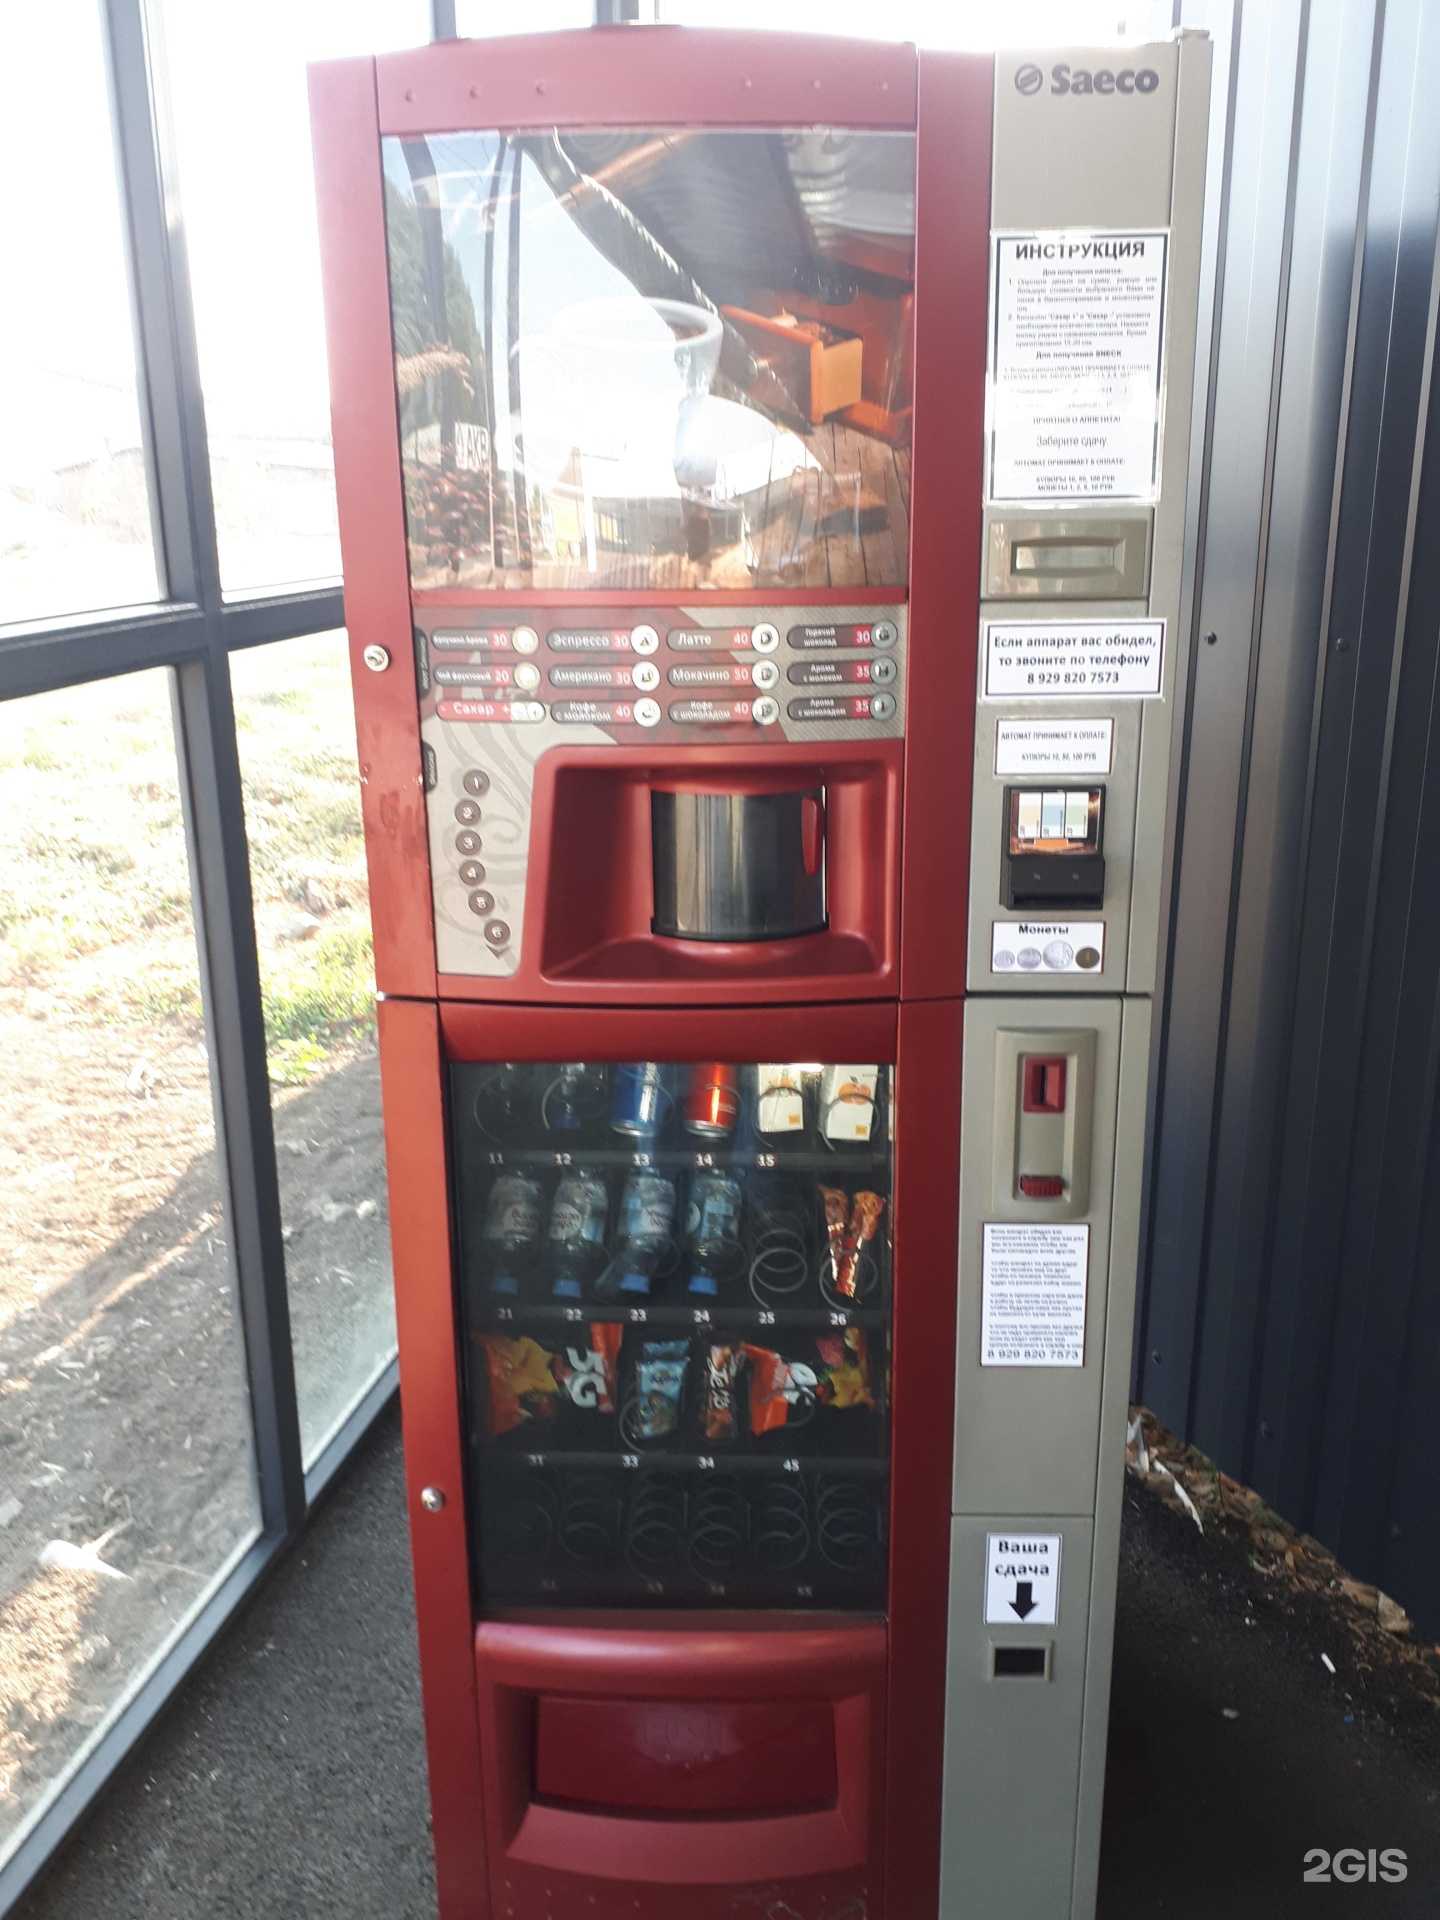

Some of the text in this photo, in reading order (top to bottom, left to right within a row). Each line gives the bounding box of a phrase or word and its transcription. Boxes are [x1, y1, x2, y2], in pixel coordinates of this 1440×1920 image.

[1050, 64, 1160, 96] Saeco
[1015, 242, 1146, 260] ИНСТРУКЦИЯ
[733, 631, 749, 645] 40
[856, 630, 871, 644] 30
[994, 633, 1157, 650] Если аппарат вас обидел,
[999, 653, 1151, 668] то звоните по телефону
[553, 668, 612, 685] Американо
[672, 667, 731, 682] Мокачино
[856, 664, 870, 678] 35
[1027, 671, 1120, 684] 8 929 820 7573
[452, 701, 496, 717] Сахар
[615, 704, 631, 718] 40
[733, 701, 749, 714] 40
[855, 699, 870, 713] 35
[1018, 924, 1070, 935] Монеты
[554, 1153, 573, 1167] 12
[633, 1153, 651, 1167] 13
[695, 1153, 713, 1167] 14
[565, 1308, 583, 1322] 22
[630, 1309, 647, 1322] 23
[693, 1309, 711, 1323] 24
[758, 1311, 776, 1325] 25
[830, 1312, 848, 1327] 26
[698, 1456, 716, 1470] 34
[998, 1540, 1049, 1554] Ваша
[994, 1562, 1050, 1577] сдача
